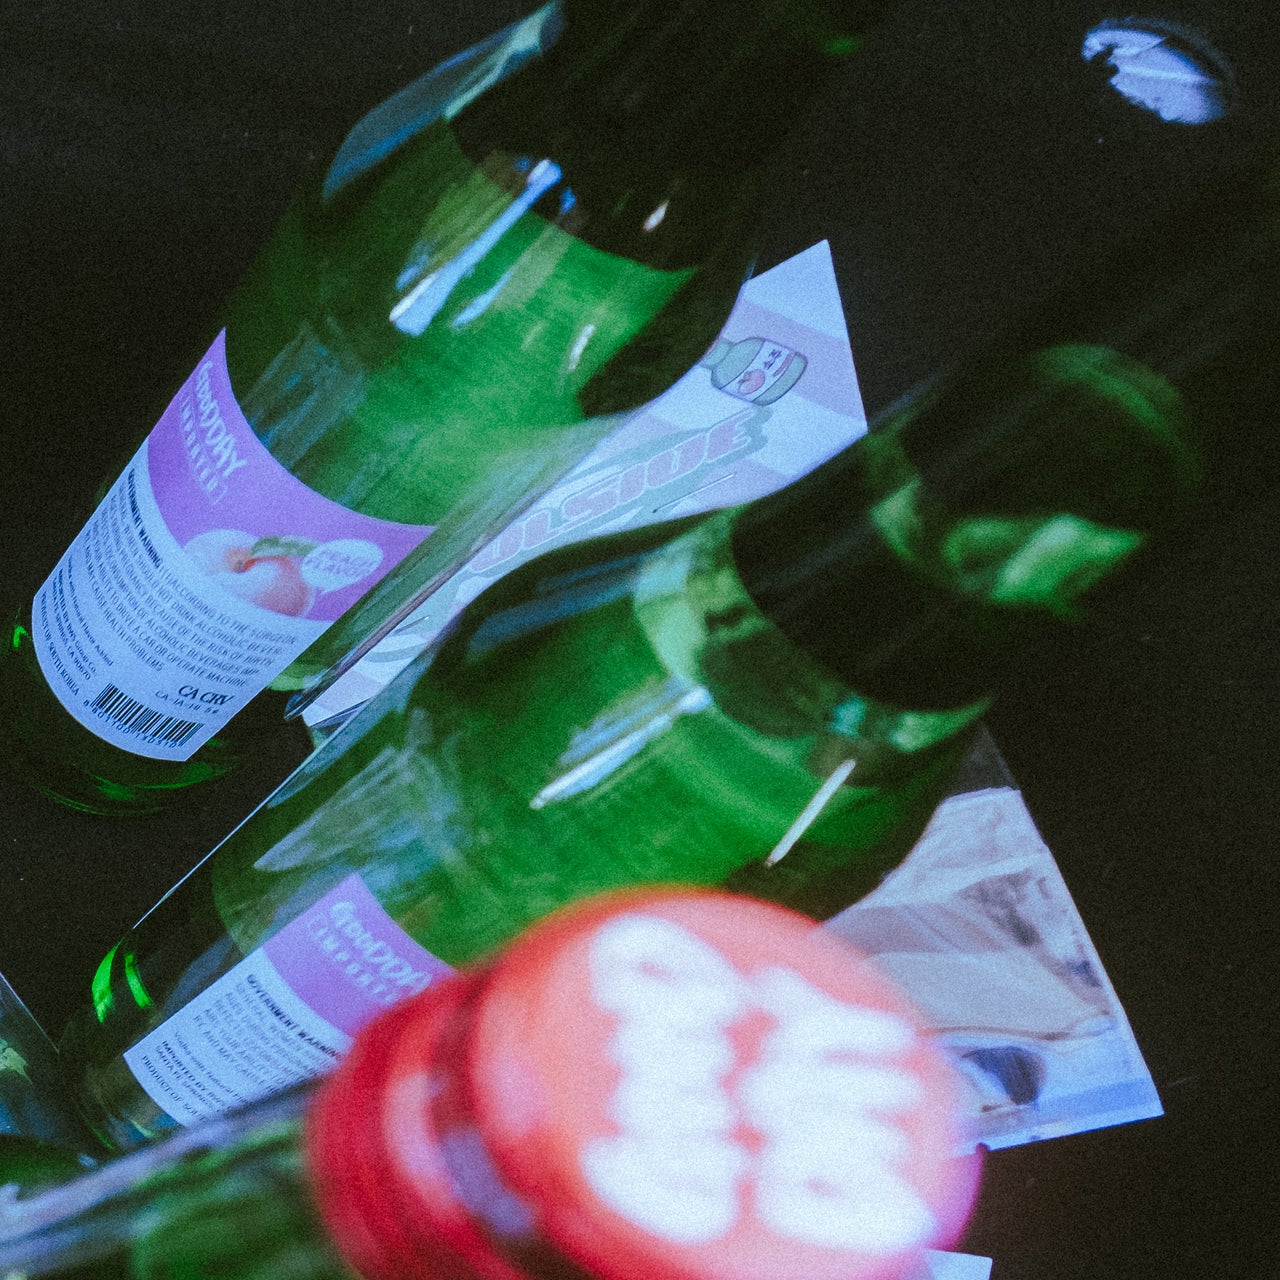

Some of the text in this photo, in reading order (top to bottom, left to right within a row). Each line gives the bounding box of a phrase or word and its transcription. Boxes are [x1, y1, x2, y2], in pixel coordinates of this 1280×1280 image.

[101, 607, 130, 639] HEALTH
[144, 594, 179, 629] BECAUSE
[156, 584, 174, 604] NOT
[194, 617, 248, 648] ALCOHOLIC
[115, 602, 136, 629] DRIVE
[137, 629, 156, 648] CAR
[153, 643, 169, 657] OR
[166, 650, 207, 678] OPERATE
[144, 616, 189, 653] ALCOHOLIC
[178, 684, 235, 706] CA CRV
